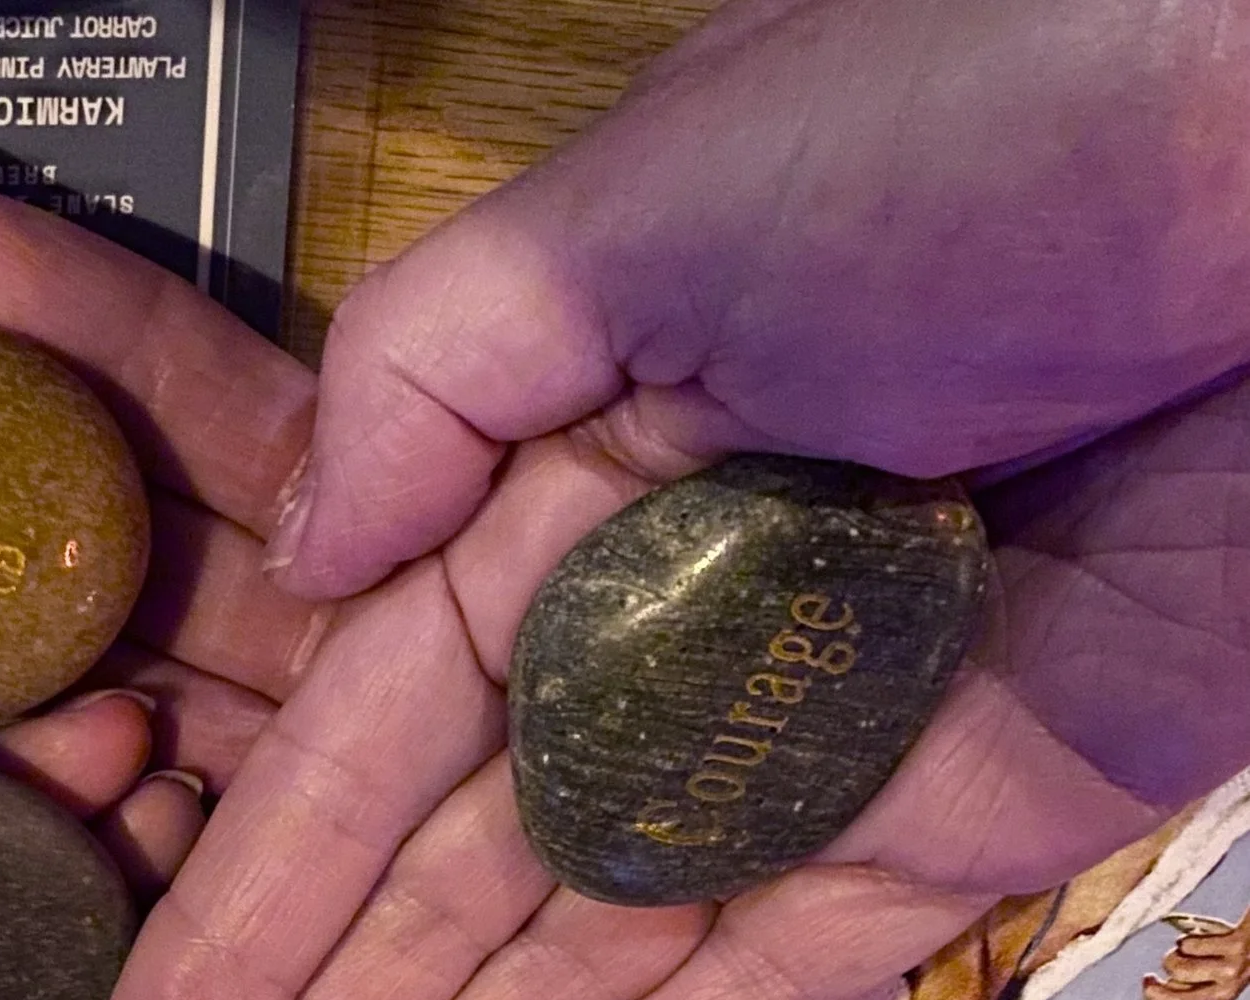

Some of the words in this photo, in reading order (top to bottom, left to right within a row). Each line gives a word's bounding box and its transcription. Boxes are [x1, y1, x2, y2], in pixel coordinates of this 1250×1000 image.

[69, 15, 158, 39] CARROT
[56, 56, 187, 80] PLANTERAY
[631, 593, 857, 847] Courage
